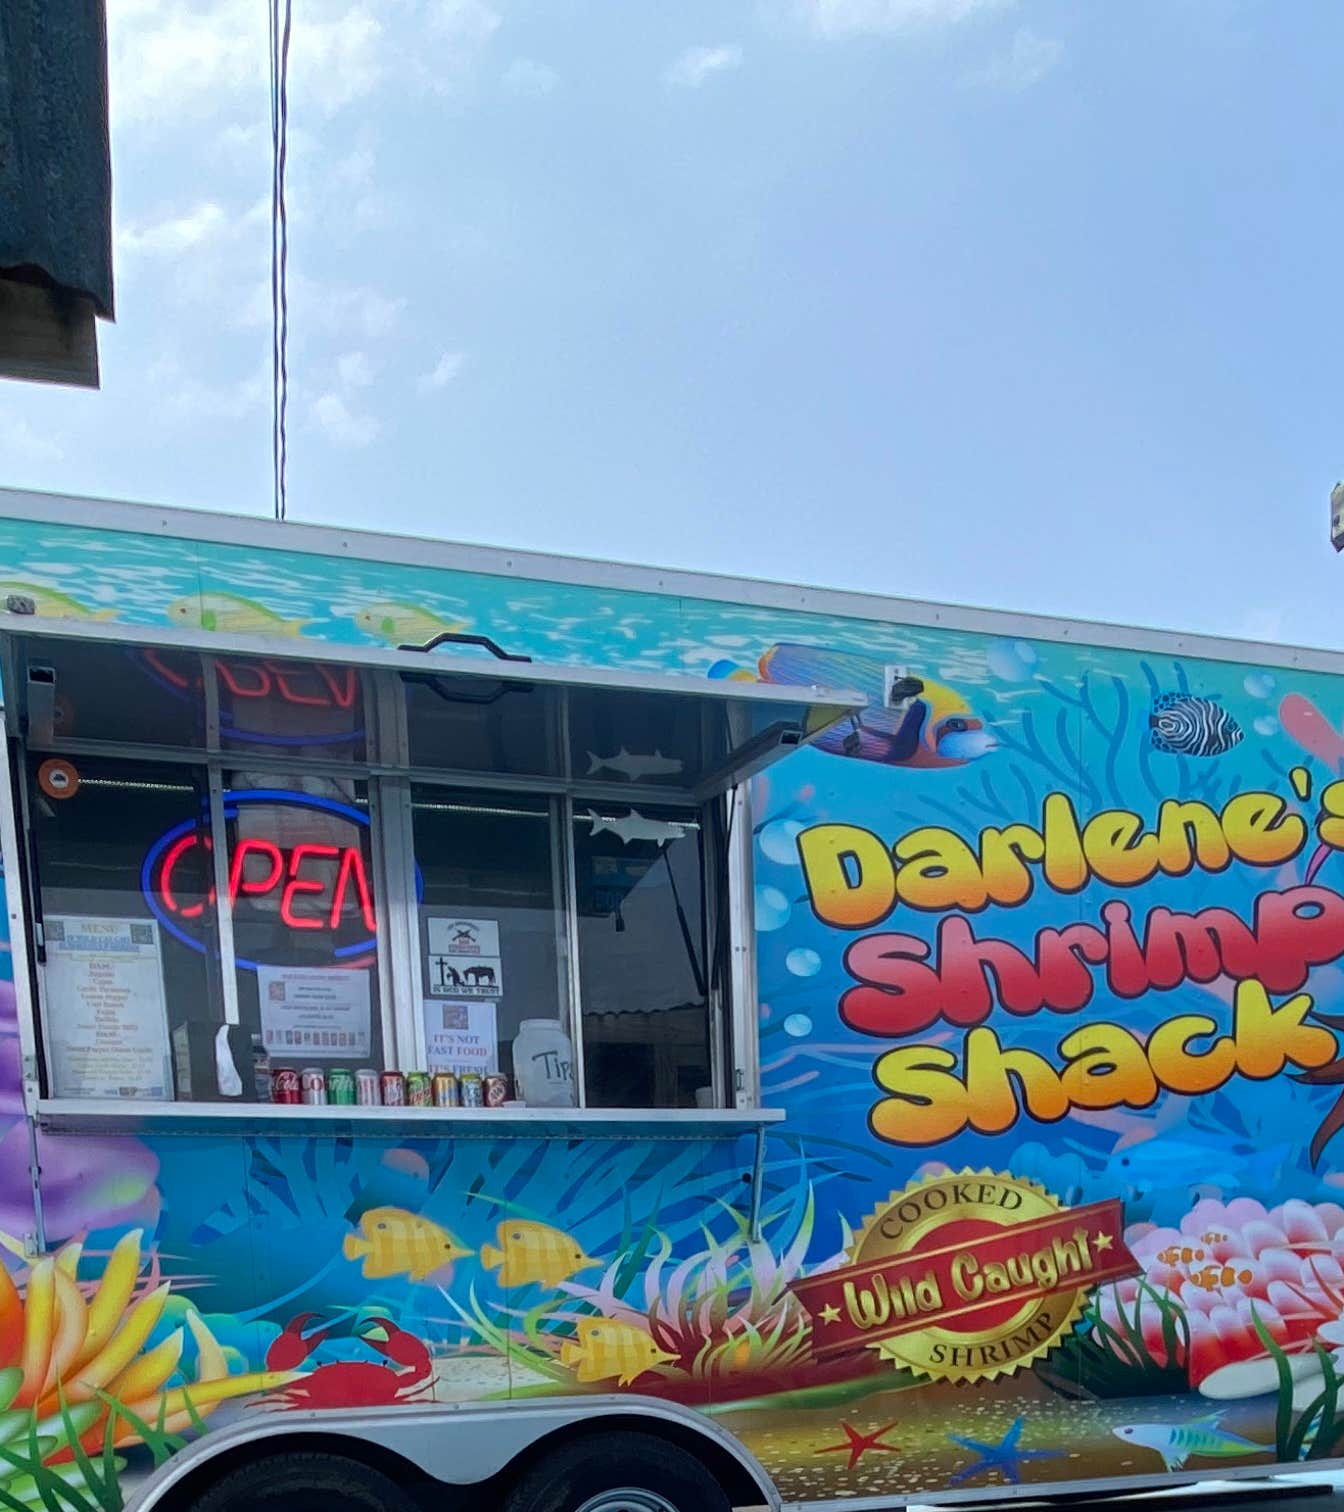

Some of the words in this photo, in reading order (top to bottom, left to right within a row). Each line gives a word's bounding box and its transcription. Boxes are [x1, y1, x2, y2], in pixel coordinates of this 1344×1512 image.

[476, 986, 500, 995] TRUST
[428, 1045, 455, 1056] FAST
[457, 1046, 487, 1057] FOOD
[433, 1033, 454, 1044] IT'S
[456, 1034, 481, 1045] NOT
[867, 978, 1338, 1148] Shack
[879, 1182, 1023, 1241] COOKED
[843, 1270, 940, 1331] Wild
[952, 1227, 1095, 1303] Caught
[928, 1311, 1055, 1368] SHRIMP
